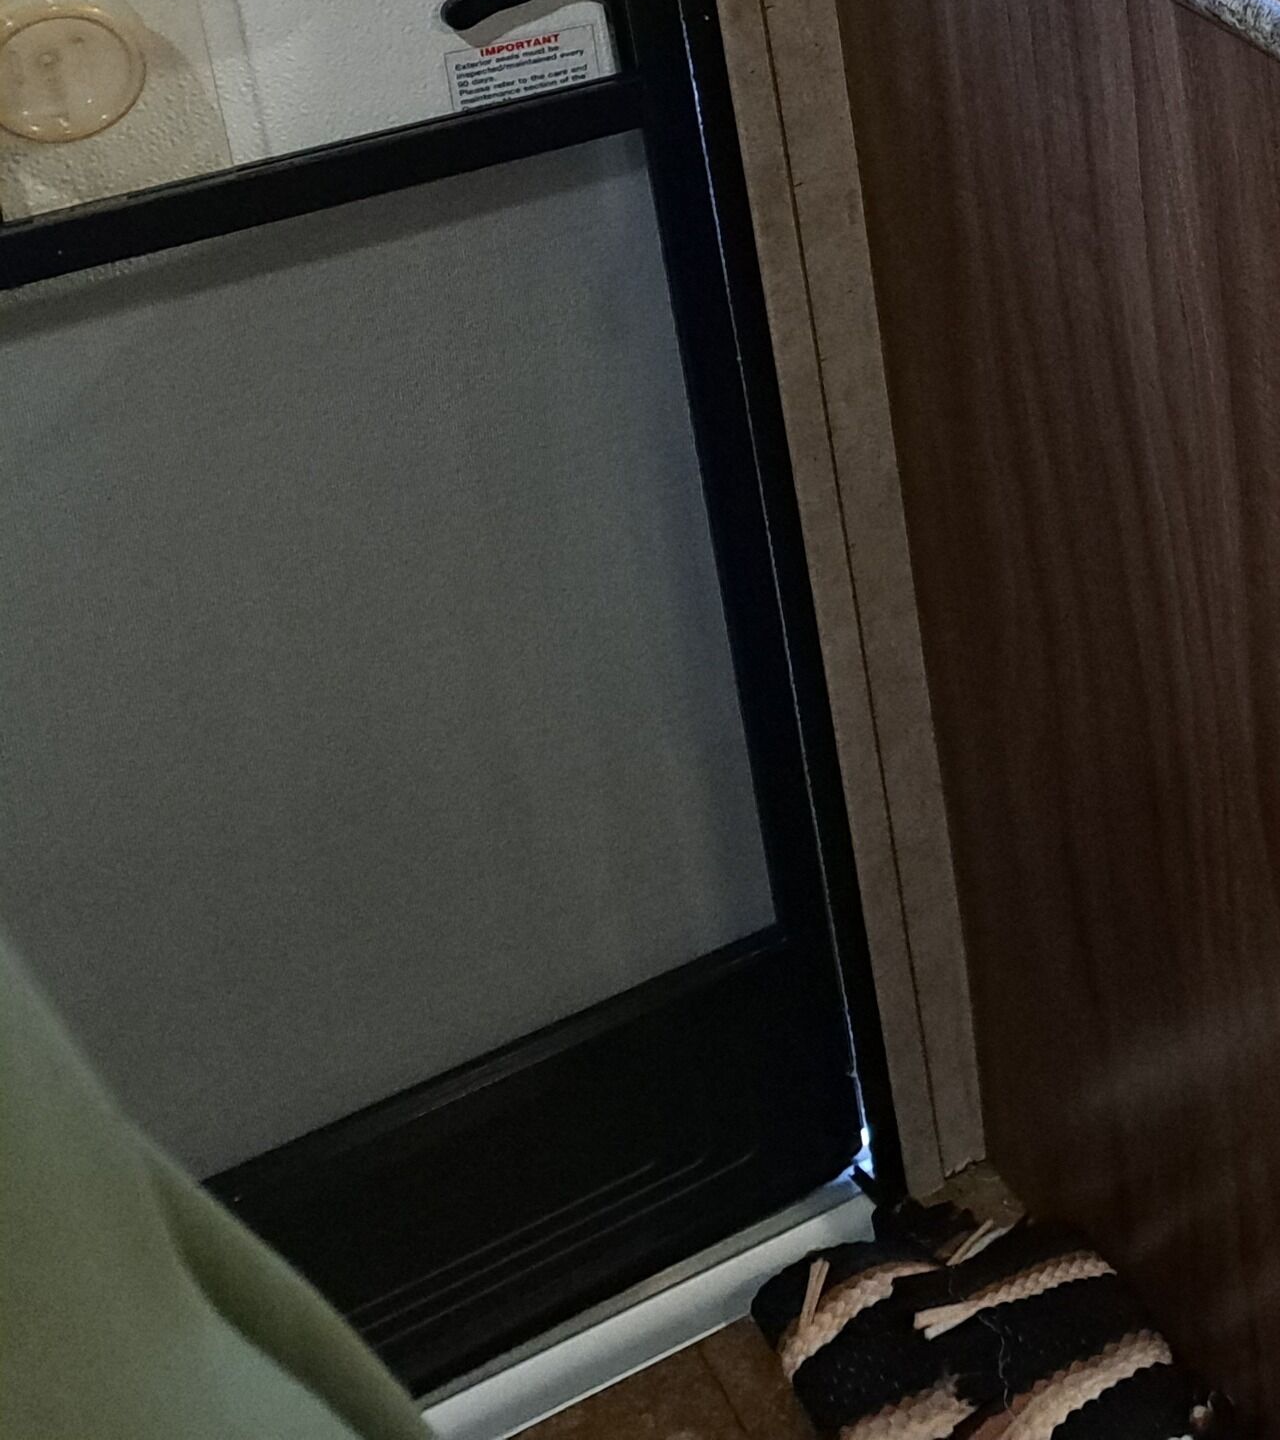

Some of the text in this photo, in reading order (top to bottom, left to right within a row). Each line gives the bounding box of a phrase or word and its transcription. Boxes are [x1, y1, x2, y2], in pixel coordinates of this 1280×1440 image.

[454, 59, 492, 71] Exterior
[495, 52, 519, 62] seals
[522, 48, 544, 58] must
[480, 33, 560, 57] IMPORTANT
[456, 49, 584, 80] inspected/maintained every
[459, 86, 490, 96] Please
[494, 79, 515, 89] refer
[531, 71, 545, 81] the
[548, 69, 568, 77] care
[571, 64, 587, 73] and
[460, 88, 520, 105] maintenance
[524, 79, 558, 92] section
[561, 76, 568, 84] of
